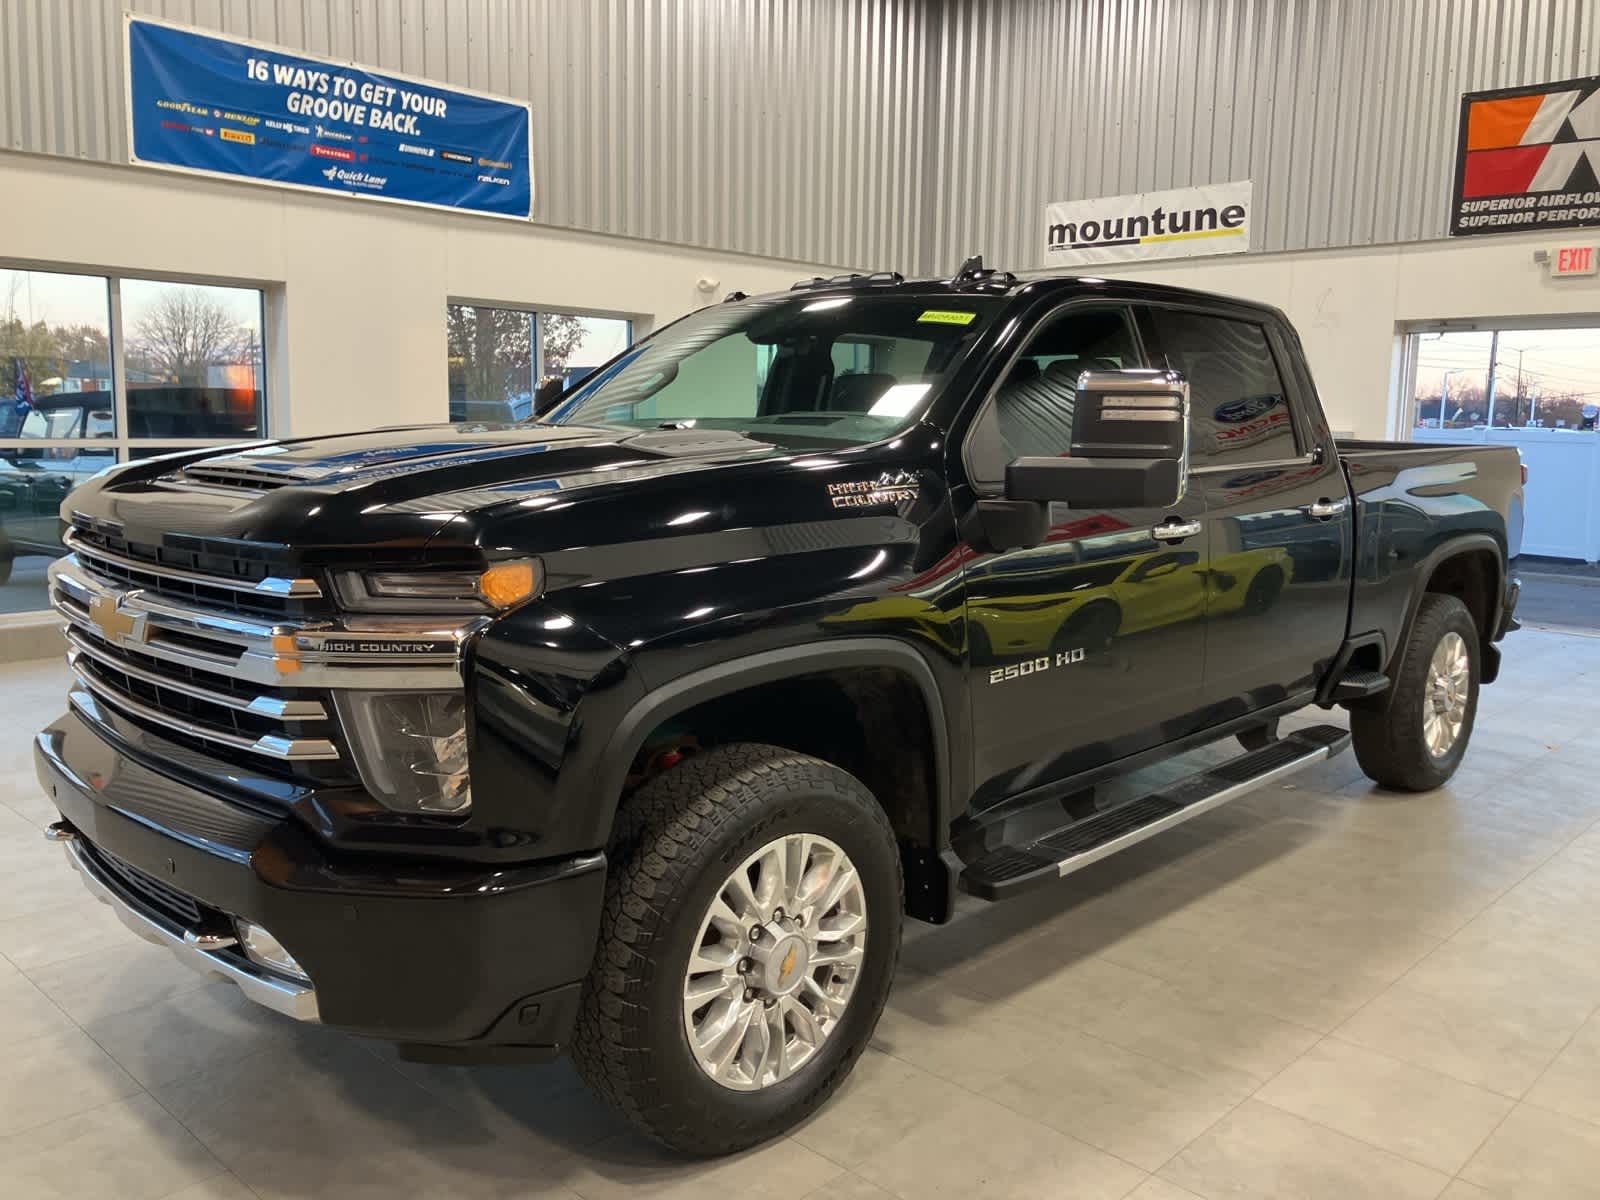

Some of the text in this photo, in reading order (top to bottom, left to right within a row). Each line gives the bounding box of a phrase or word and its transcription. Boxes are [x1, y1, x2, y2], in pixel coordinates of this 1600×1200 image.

[247, 59, 447, 118] 16 WAYS TO GET YOUR
[287, 92, 421, 137] GROOVE BACK.
[337, 168, 363, 181] Quick
[363, 173, 388, 185] Lane
[1460, 197, 1537, 214] SUPERIOR
[1048, 204, 1246, 245] mountune
[1459, 211, 1536, 228] SUPERIOR
[1557, 247, 1593, 272] EXIT
[320, 643, 435, 652] HIGH COUNTRY
[990, 647, 1085, 684] 2500 HD
